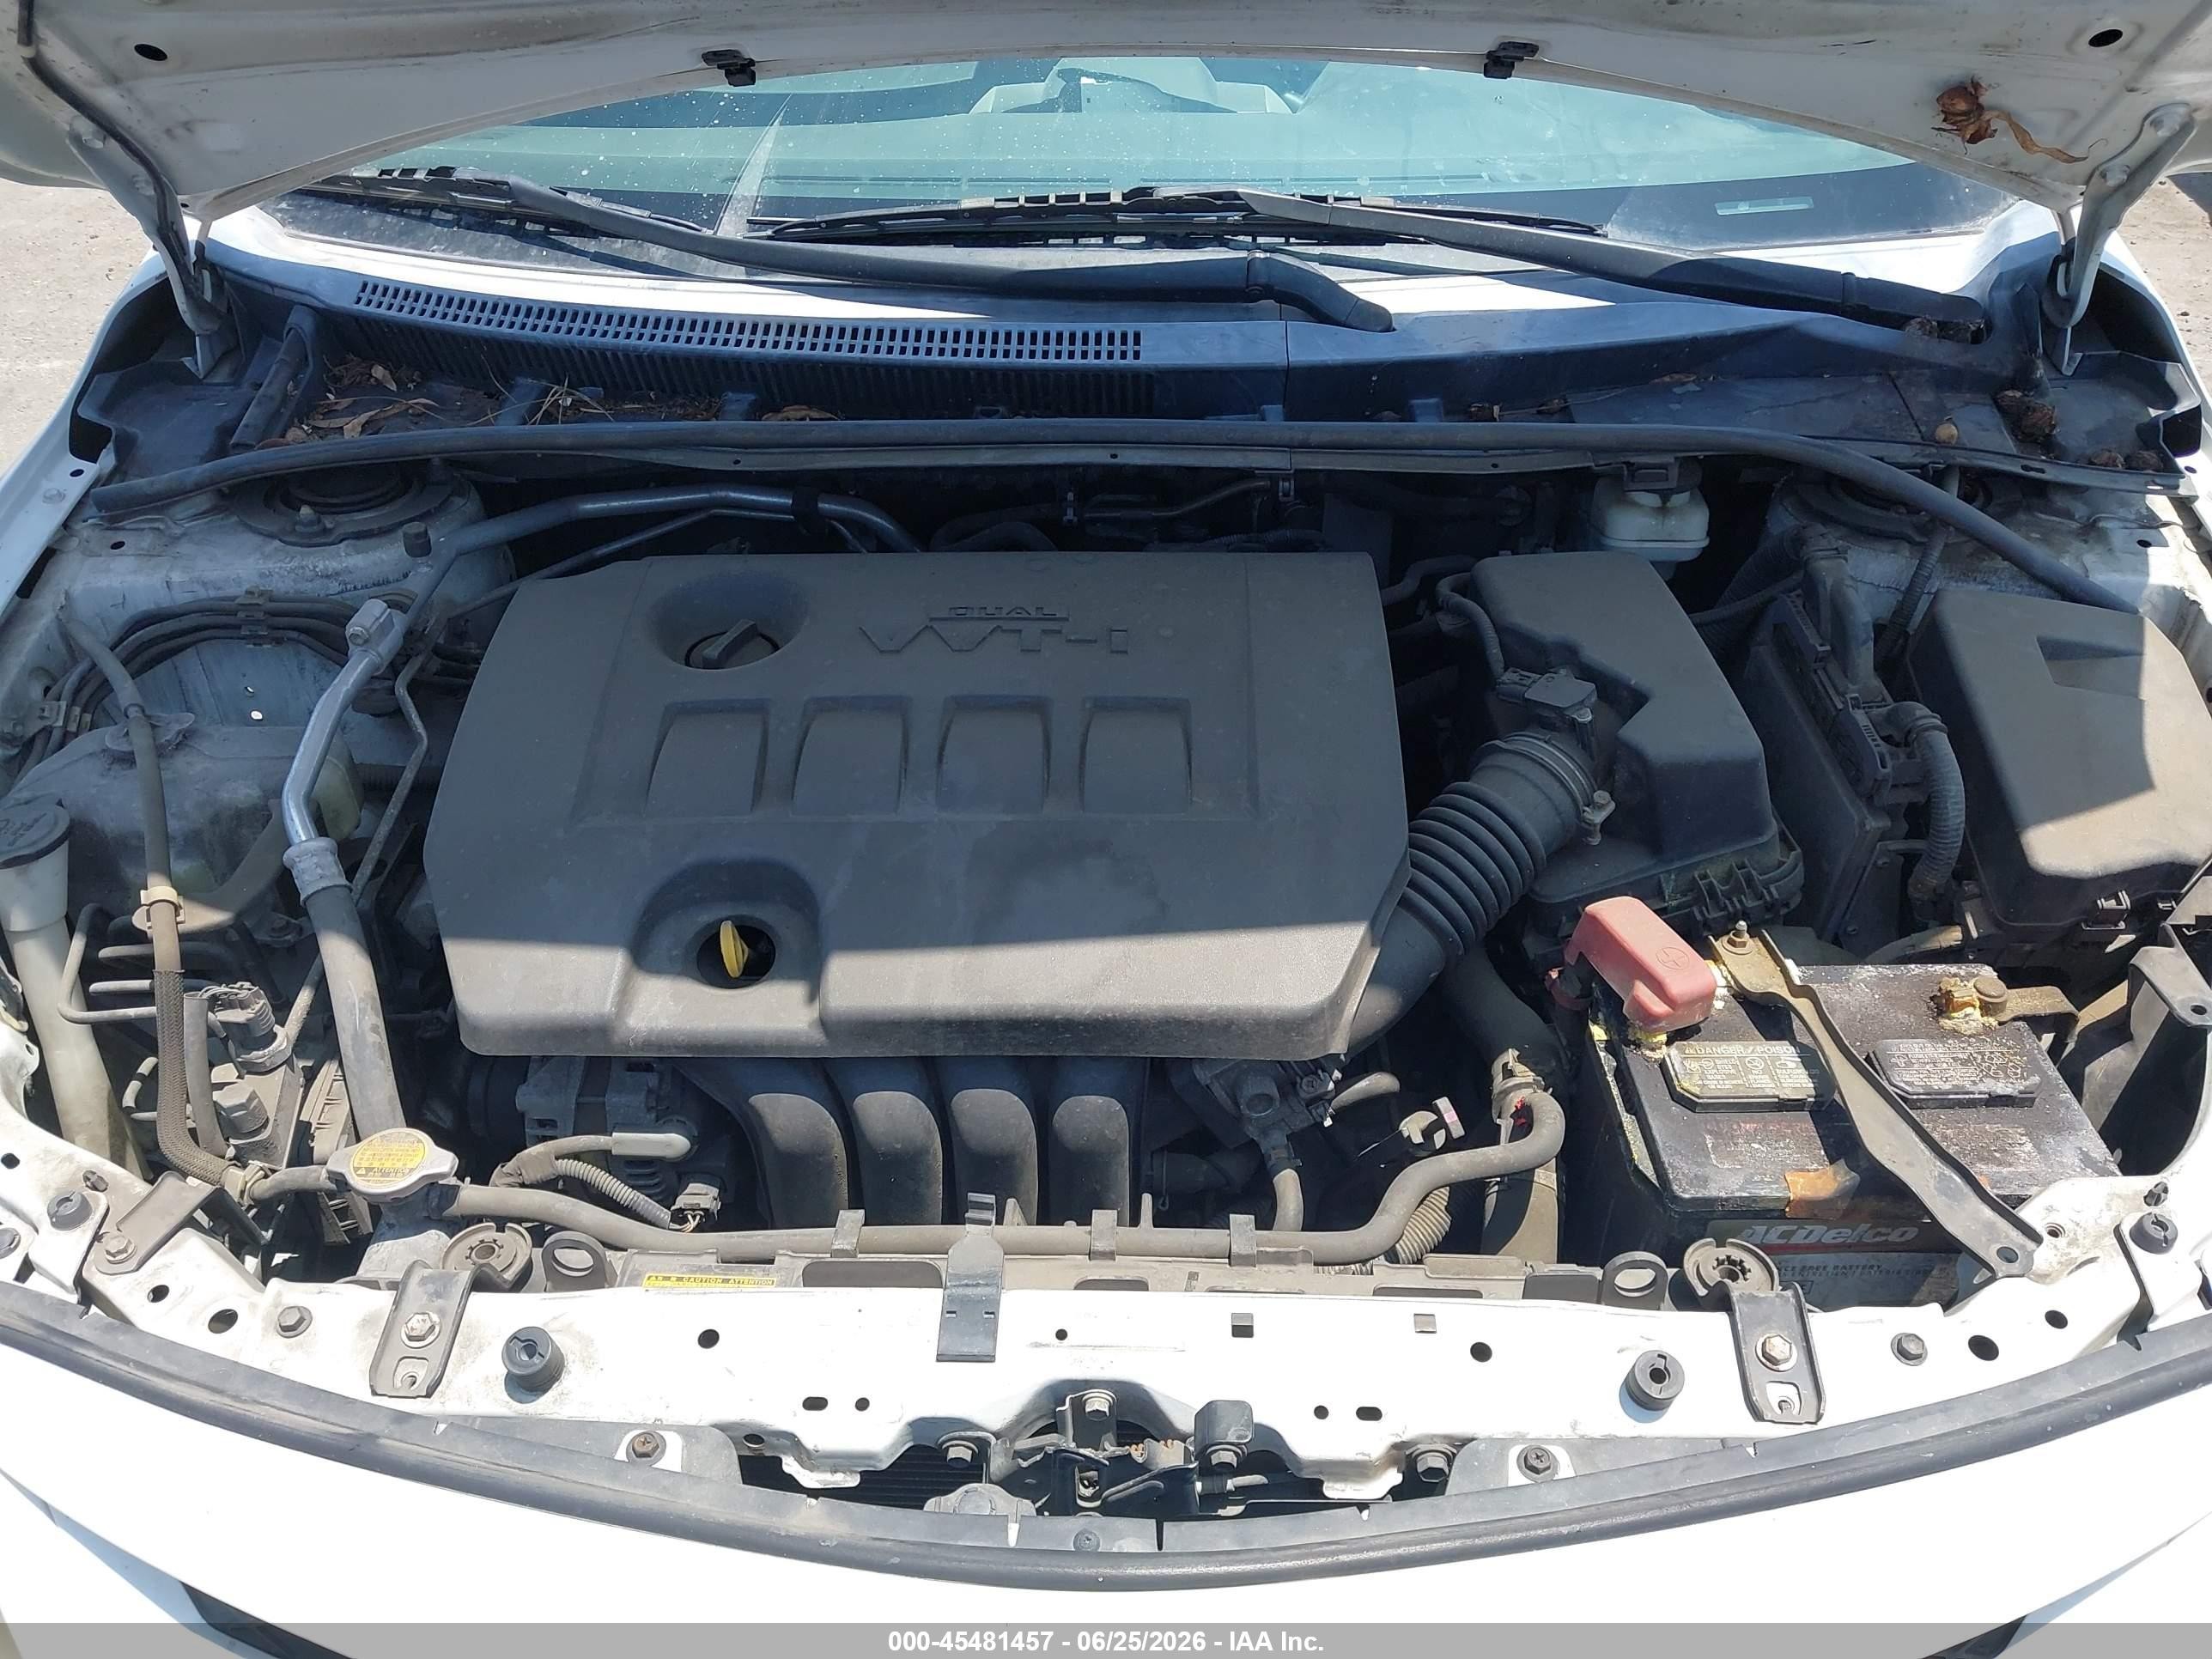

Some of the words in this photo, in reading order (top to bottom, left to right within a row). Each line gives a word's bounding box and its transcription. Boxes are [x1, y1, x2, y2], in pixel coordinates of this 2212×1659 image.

[949, 606, 1058, 617] DUAL
[1696, 1046, 1745, 1054] DANGER
[1758, 1045, 1801, 1054] POISON
[1738, 1224, 1919, 1244] ACDelco
